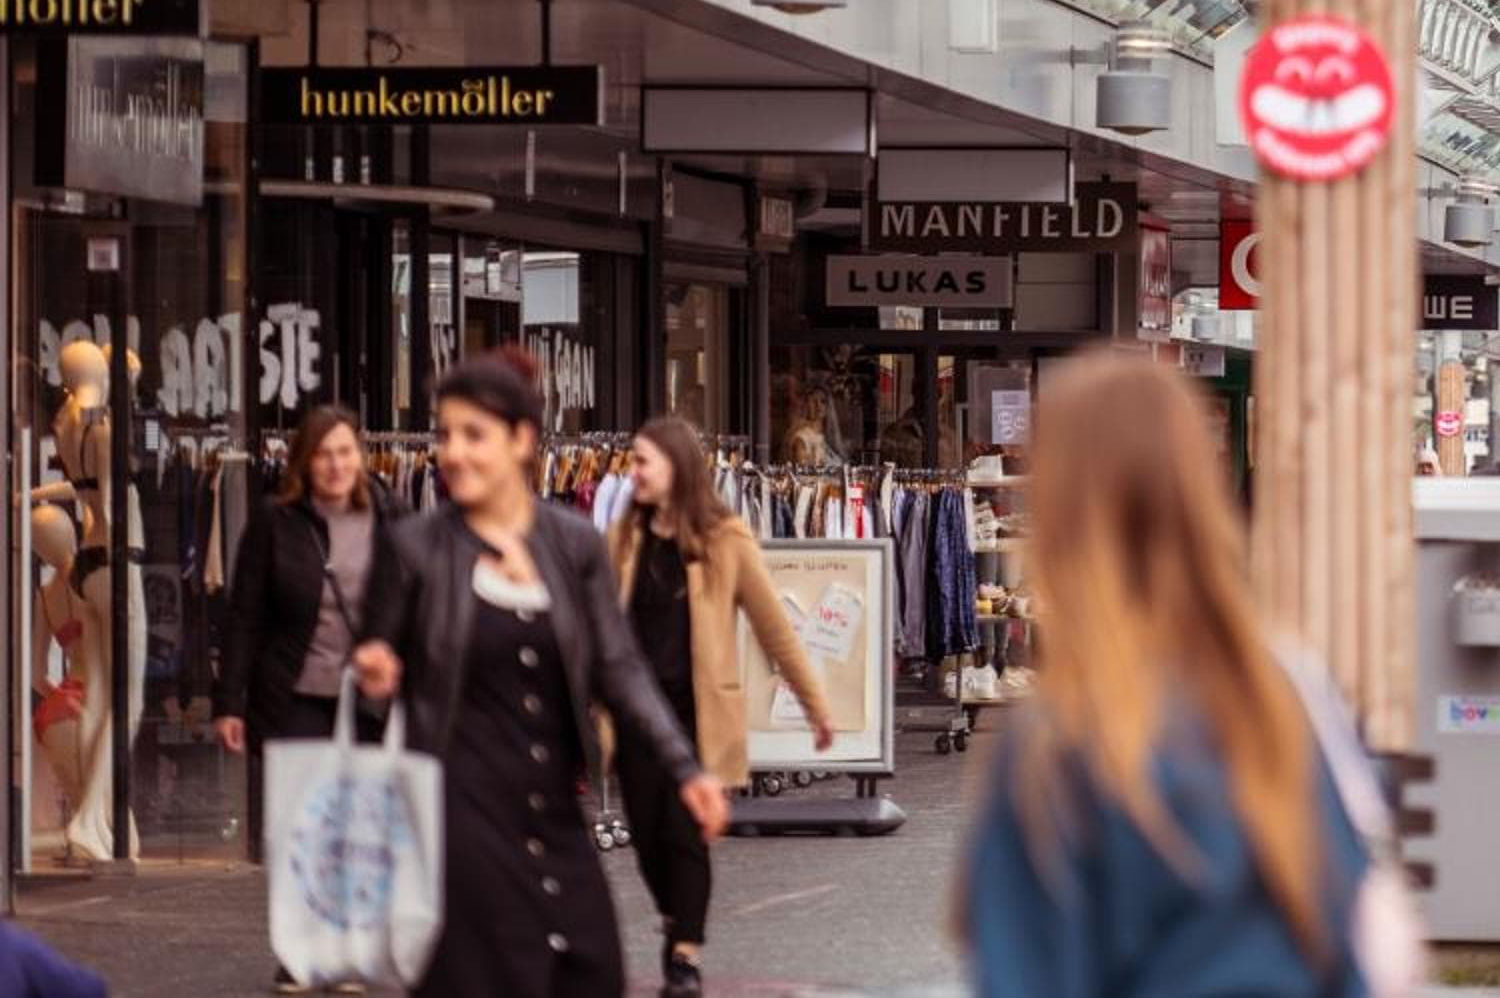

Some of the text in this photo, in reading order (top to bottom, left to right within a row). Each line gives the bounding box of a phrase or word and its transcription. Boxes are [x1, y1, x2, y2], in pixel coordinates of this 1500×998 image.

[301, 75, 554, 117] hunkemöller
[881, 199, 1124, 238] MANFIELD
[848, 269, 987, 294] LUKAS
[1423, 295, 1473, 319] WE
